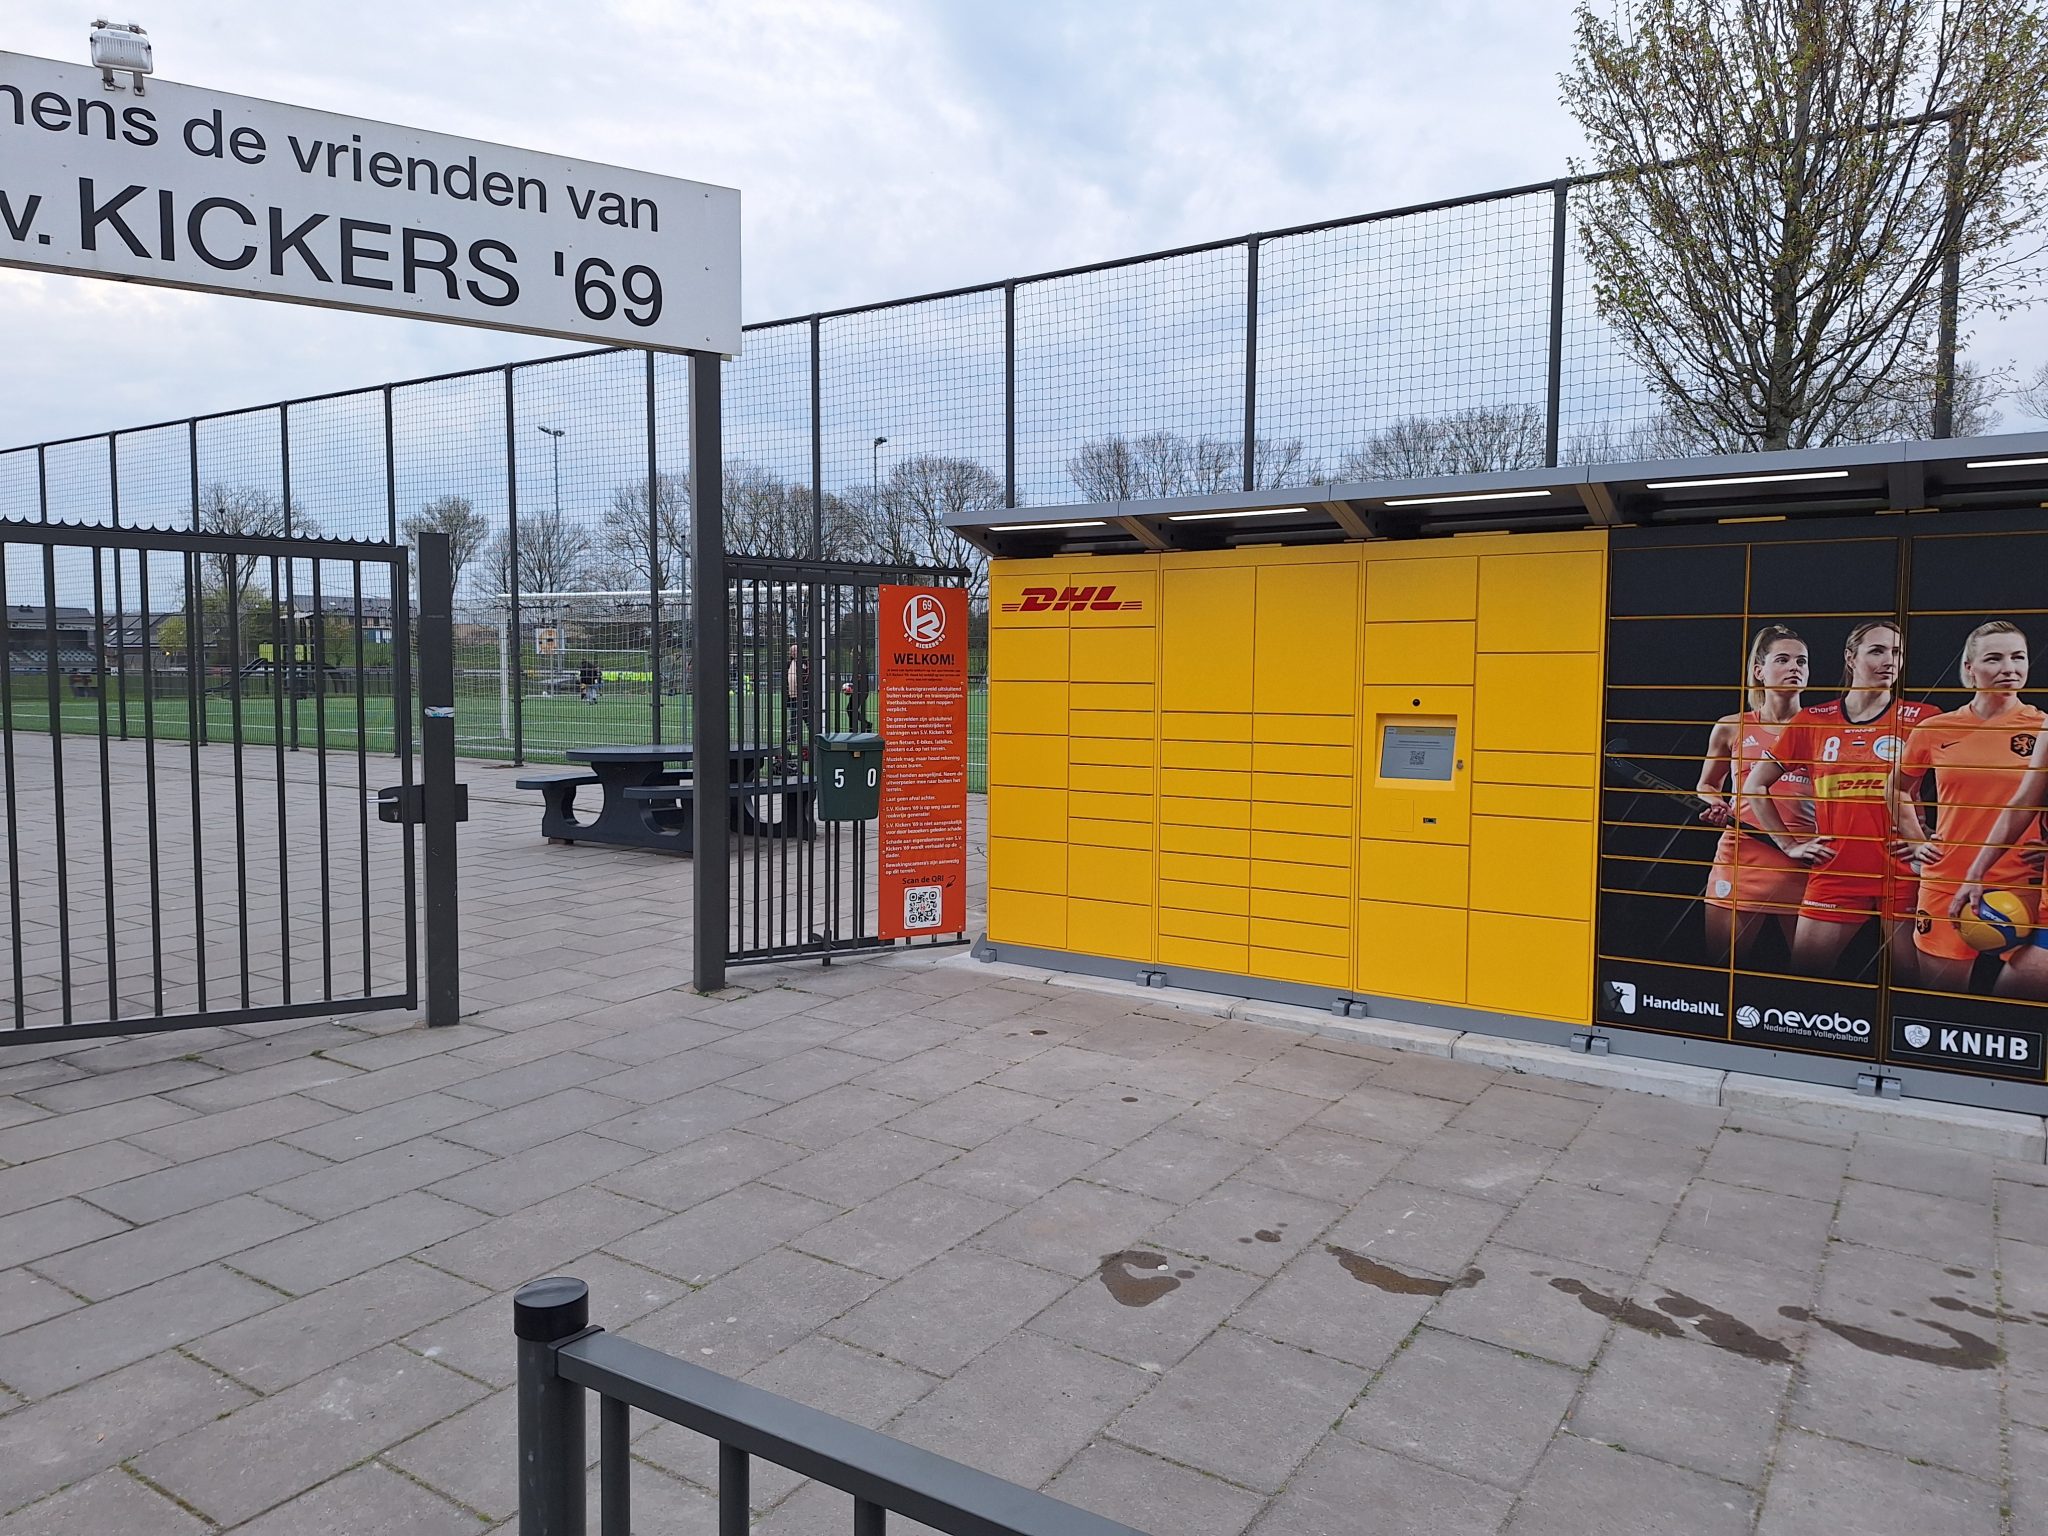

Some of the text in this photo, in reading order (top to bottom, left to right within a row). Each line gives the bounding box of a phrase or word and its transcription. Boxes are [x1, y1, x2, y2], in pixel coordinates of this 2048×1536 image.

[183, 109, 266, 164] de
[288, 134, 547, 213] vrienden
[566, 186, 658, 232] van
[78, 177, 520, 307] KICKERS
[554, 251, 663, 326] '69
[922, 600, 932, 610] 69
[1018, 586, 1122, 612] DHL
[894, 653, 954, 665] WELKOM!
[1822, 736, 1840, 762] 8
[834, 768, 876, 788] 5 0
[1836, 779, 1884, 790] DHL
[1642, 994, 1724, 1017] HandbalNL
[1764, 1008, 1870, 1036] nevobo
[1764, 1024, 1869, 1044] Nederlandse Volleybalbond
[1940, 1028, 2028, 1060] KNHB
